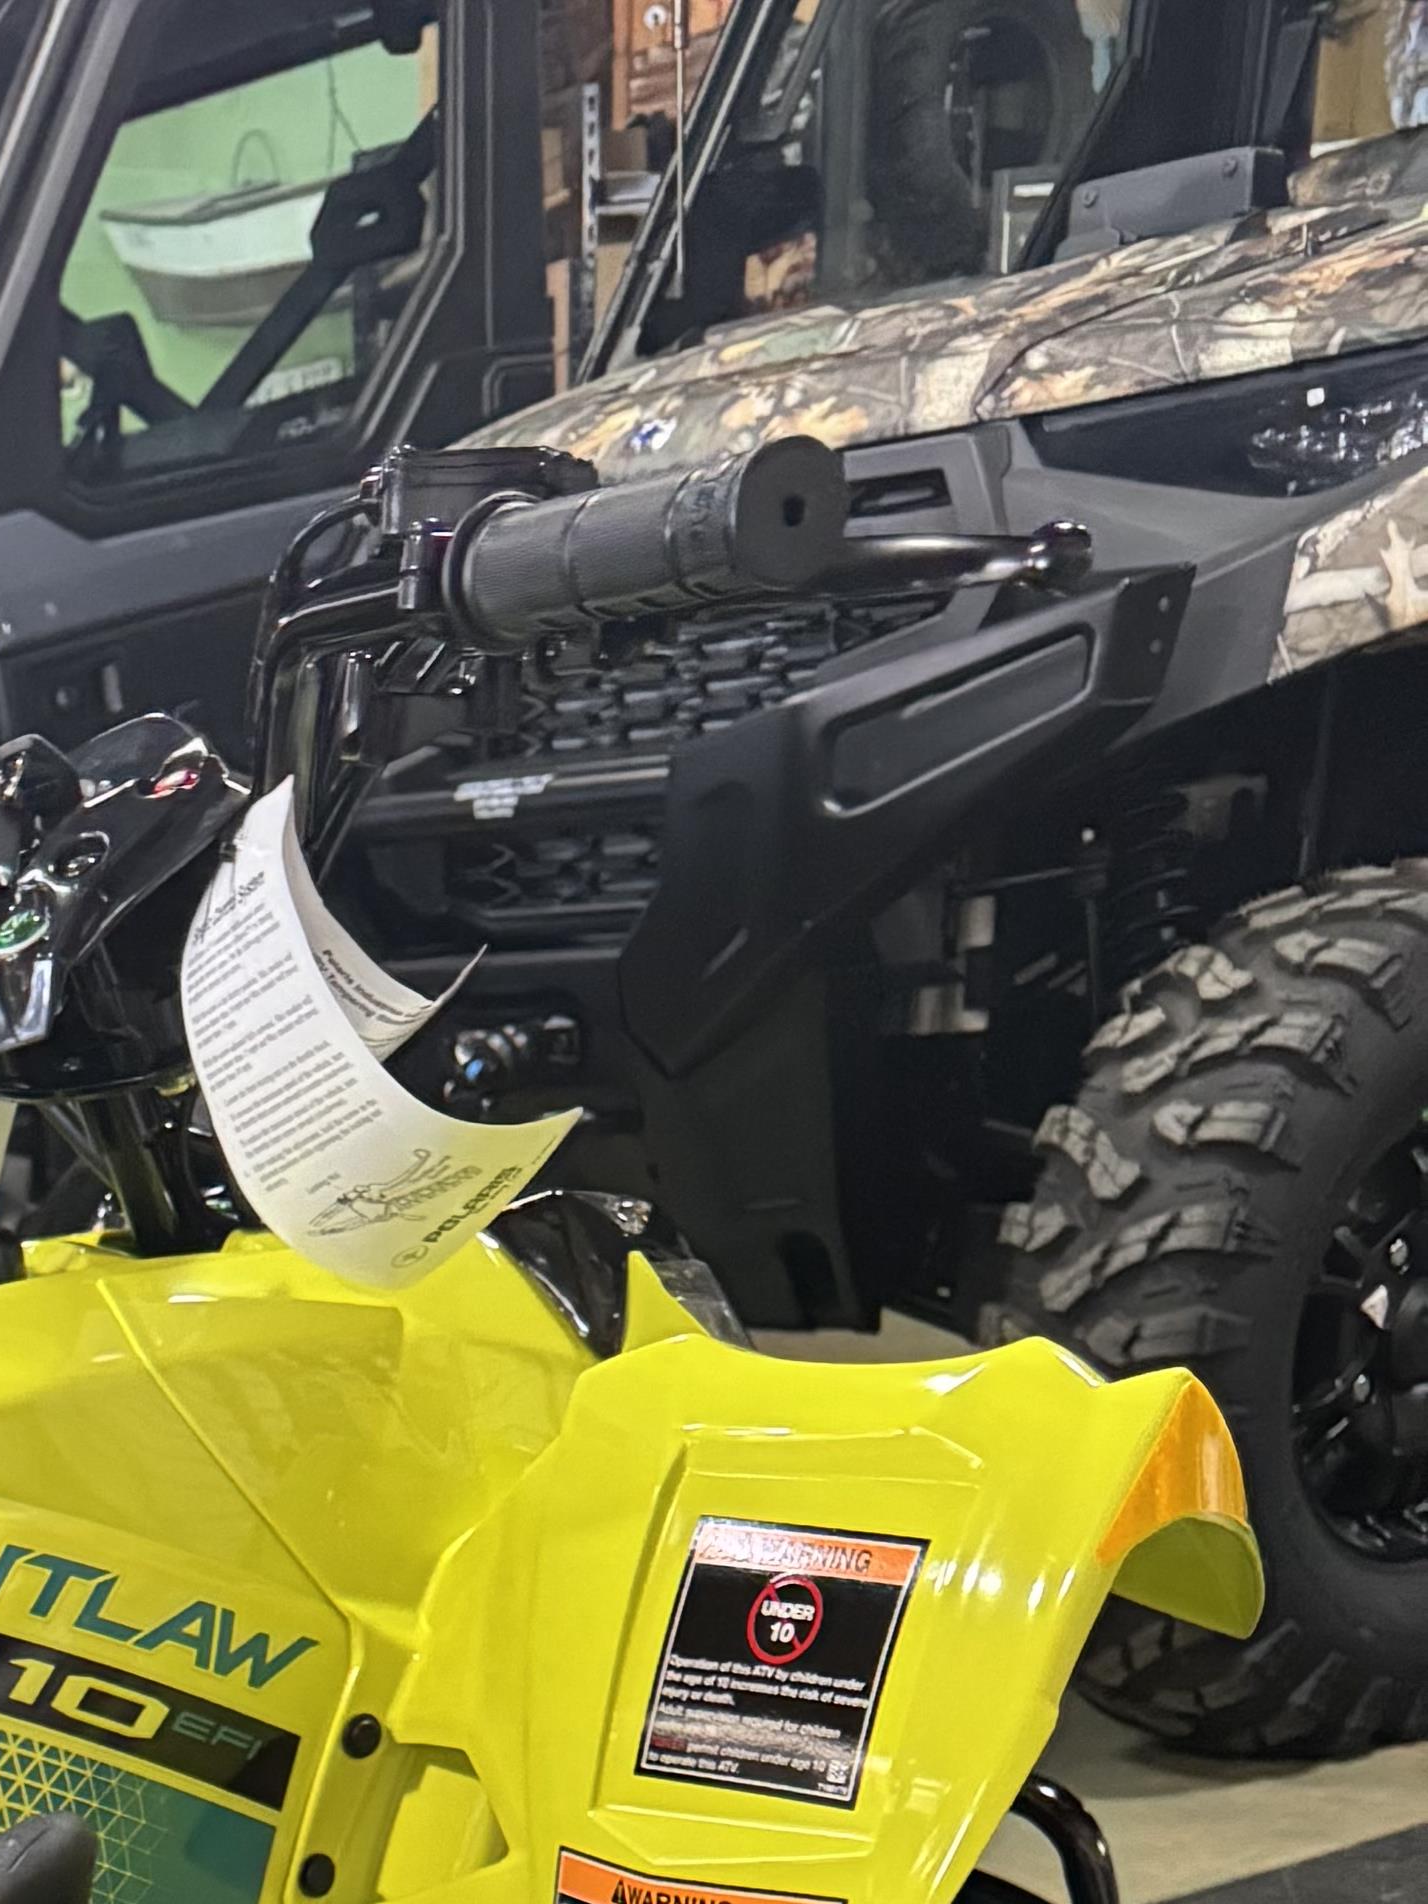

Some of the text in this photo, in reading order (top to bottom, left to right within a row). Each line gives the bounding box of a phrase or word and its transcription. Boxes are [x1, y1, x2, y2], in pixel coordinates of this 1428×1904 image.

[760, 1600, 815, 1621] UNDER
[770, 1621, 795, 1644] 10
[669, 1654, 719, 1671] Operation
[719, 1661, 732, 1673] of
[752, 1664, 775, 1678] ATV
[775, 1667, 789, 1682] by
[790, 1671, 833, 1686] children
[703, 1675, 717, 1686] of
[820, 1691, 834, 1703] of
[172, 1711, 262, 1760] EFI
